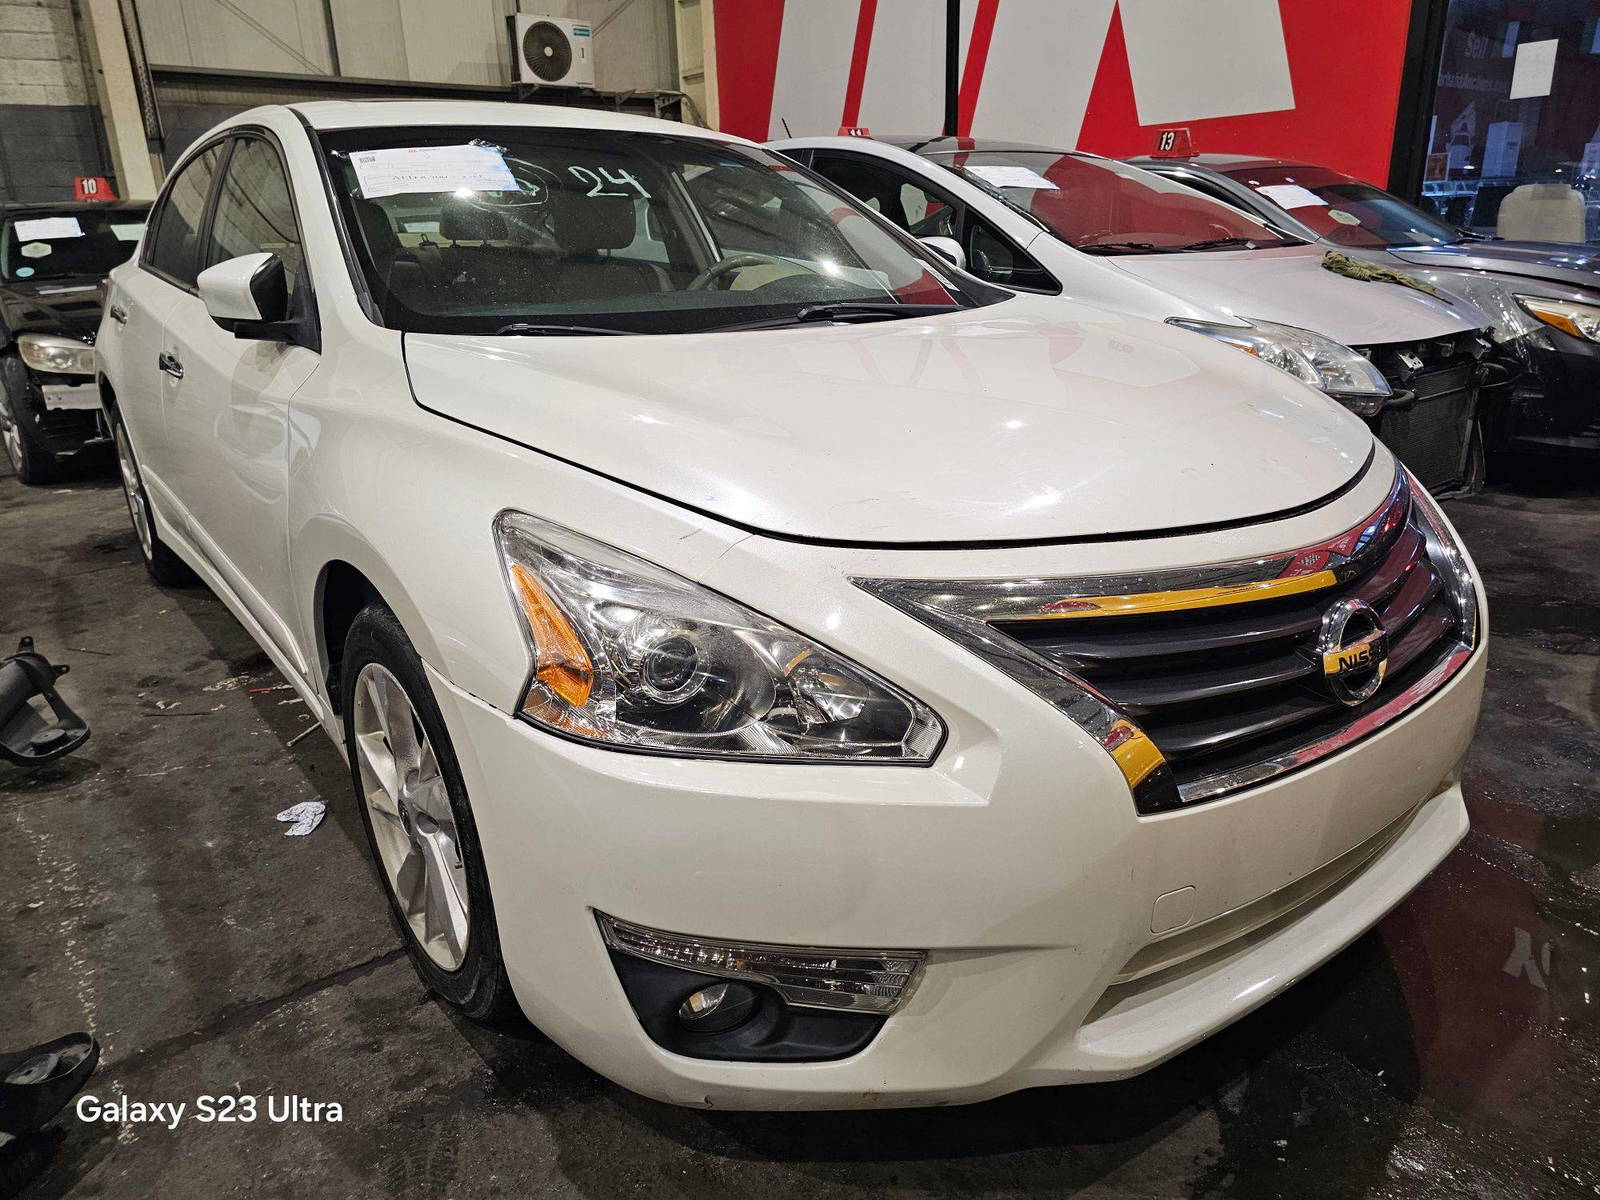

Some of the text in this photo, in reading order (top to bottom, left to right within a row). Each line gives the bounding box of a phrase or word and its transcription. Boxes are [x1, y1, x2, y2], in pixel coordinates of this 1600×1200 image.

[1159, 131, 1176, 151] 13
[81, 178, 98, 195] 10
[568, 166, 652, 199] 24
